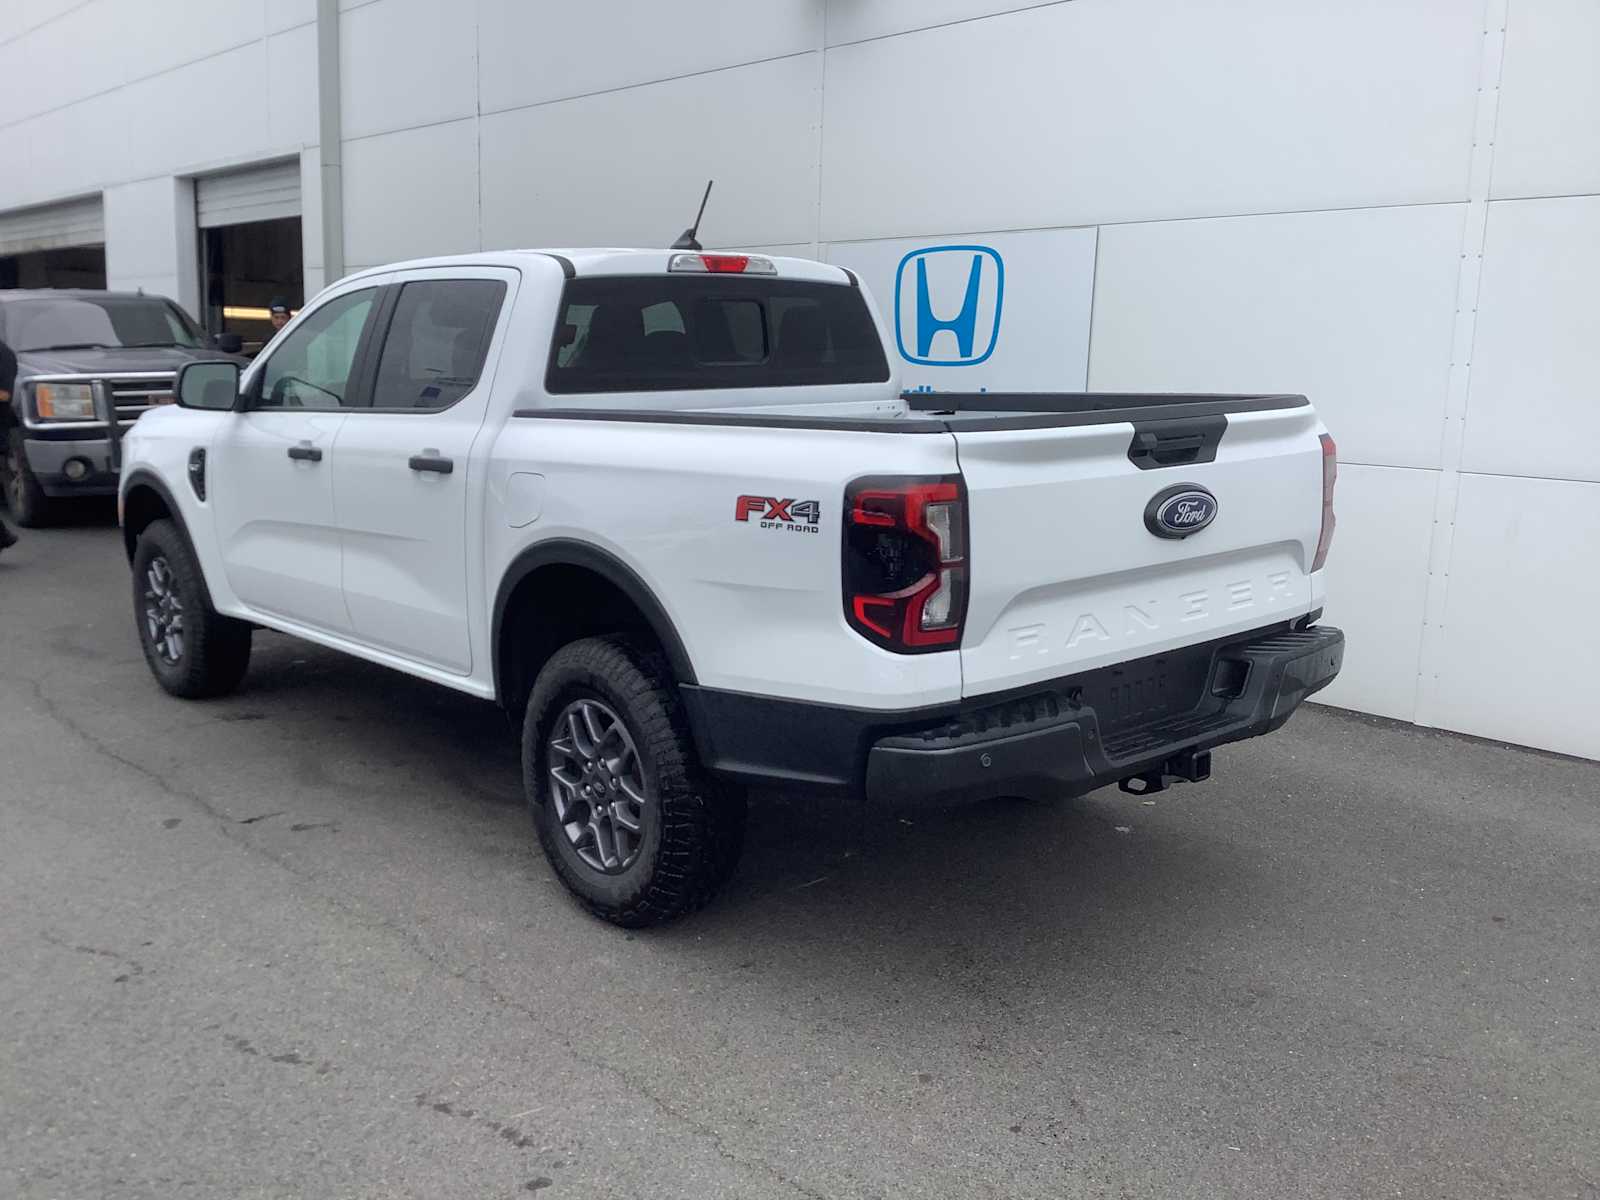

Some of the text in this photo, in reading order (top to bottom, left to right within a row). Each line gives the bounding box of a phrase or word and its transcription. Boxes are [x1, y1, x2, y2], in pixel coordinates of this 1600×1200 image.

[735, 495, 820, 524] FX4
[1174, 501, 1207, 524] Ford
[760, 521, 819, 534] OFF ROAD
[1007, 569, 1296, 661] RANGER
